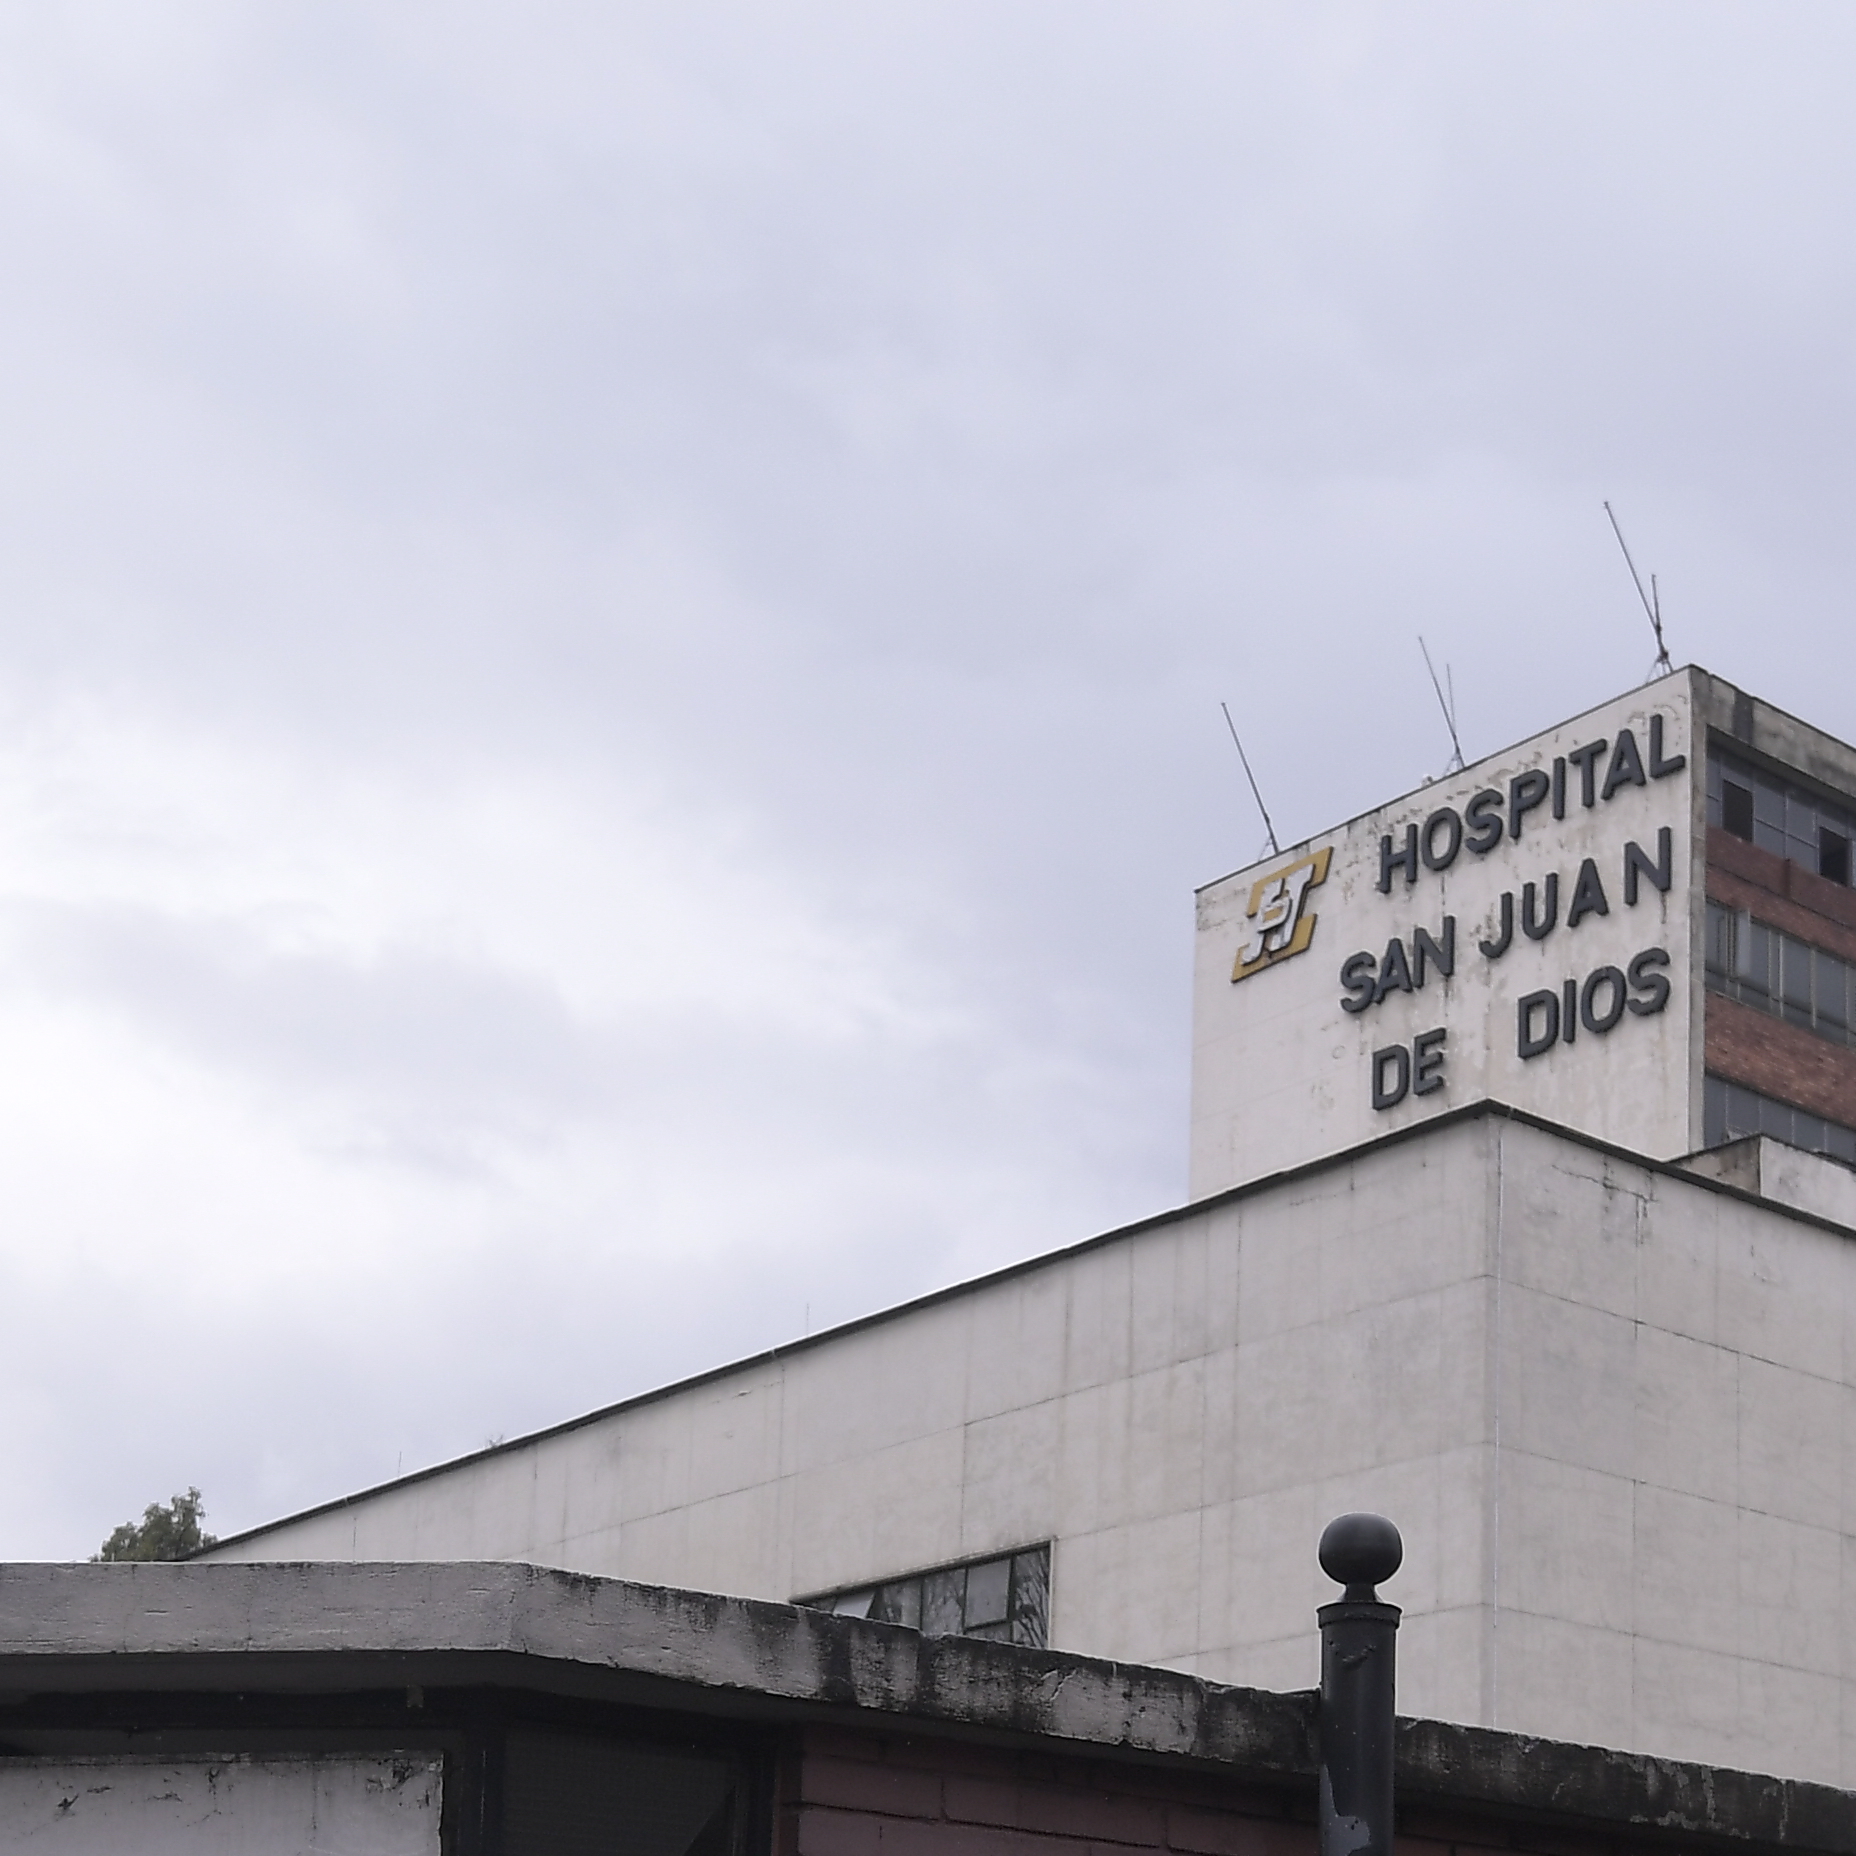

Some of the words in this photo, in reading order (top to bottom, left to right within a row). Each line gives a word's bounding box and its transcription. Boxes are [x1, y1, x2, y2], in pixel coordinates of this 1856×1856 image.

[1376, 713, 1686, 895] HOSPITAL
[1339, 914, 1457, 1014] SAN
[1478, 825, 1673, 961] JUAN
[1371, 1026, 1447, 1112] DE
[1517, 946, 1672, 1061] DIOS
